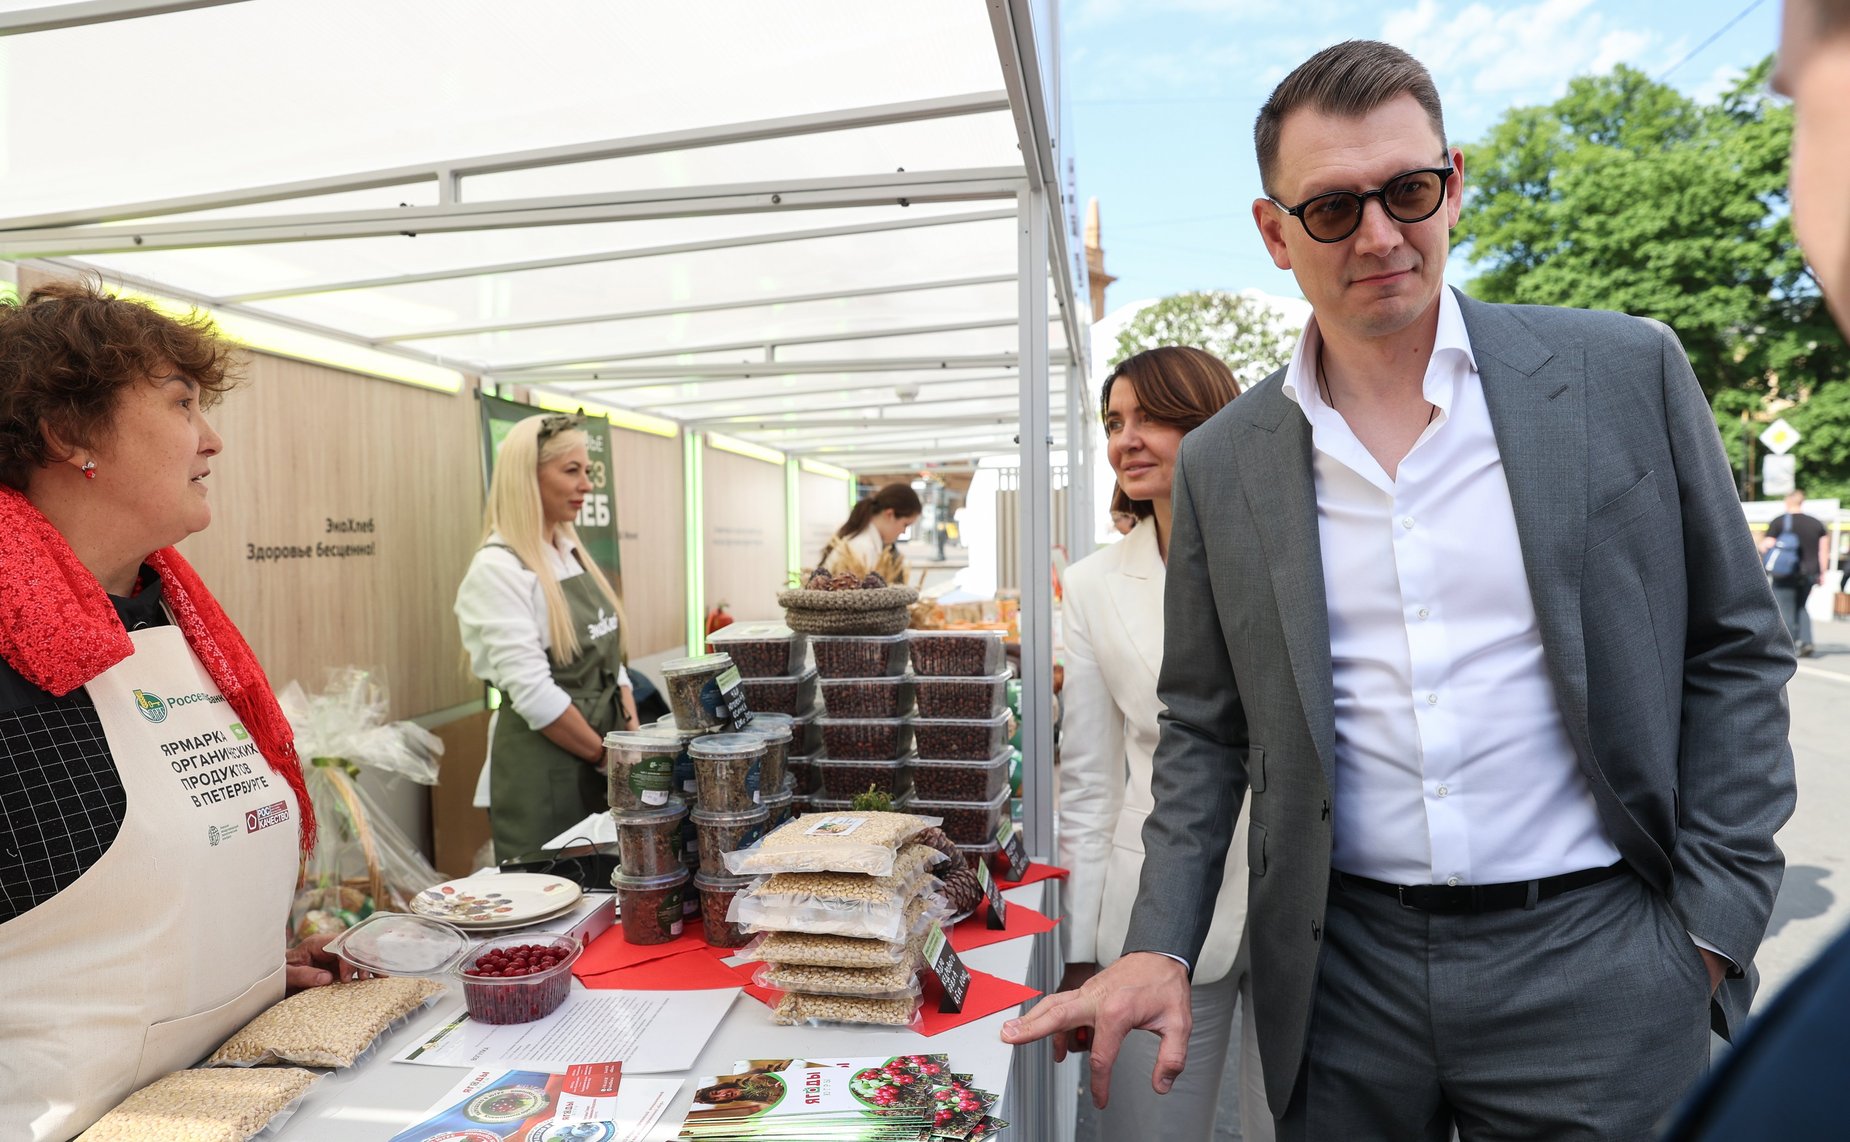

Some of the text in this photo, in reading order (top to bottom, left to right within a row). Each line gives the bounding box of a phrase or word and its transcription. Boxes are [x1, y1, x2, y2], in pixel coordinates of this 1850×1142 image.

[247, 541, 375, 562] Здоровье бесценно!
[160, 730, 227, 757] ЯРМАРКА
[180, 762, 252, 791] ПРОДУКТОВ
[191, 775, 269, 808] В ПЕТЕРБУРГЕ
[258, 810, 290, 829] КАЧЕСТВО
[803, 1072, 821, 1104] ЯГОДЫ
